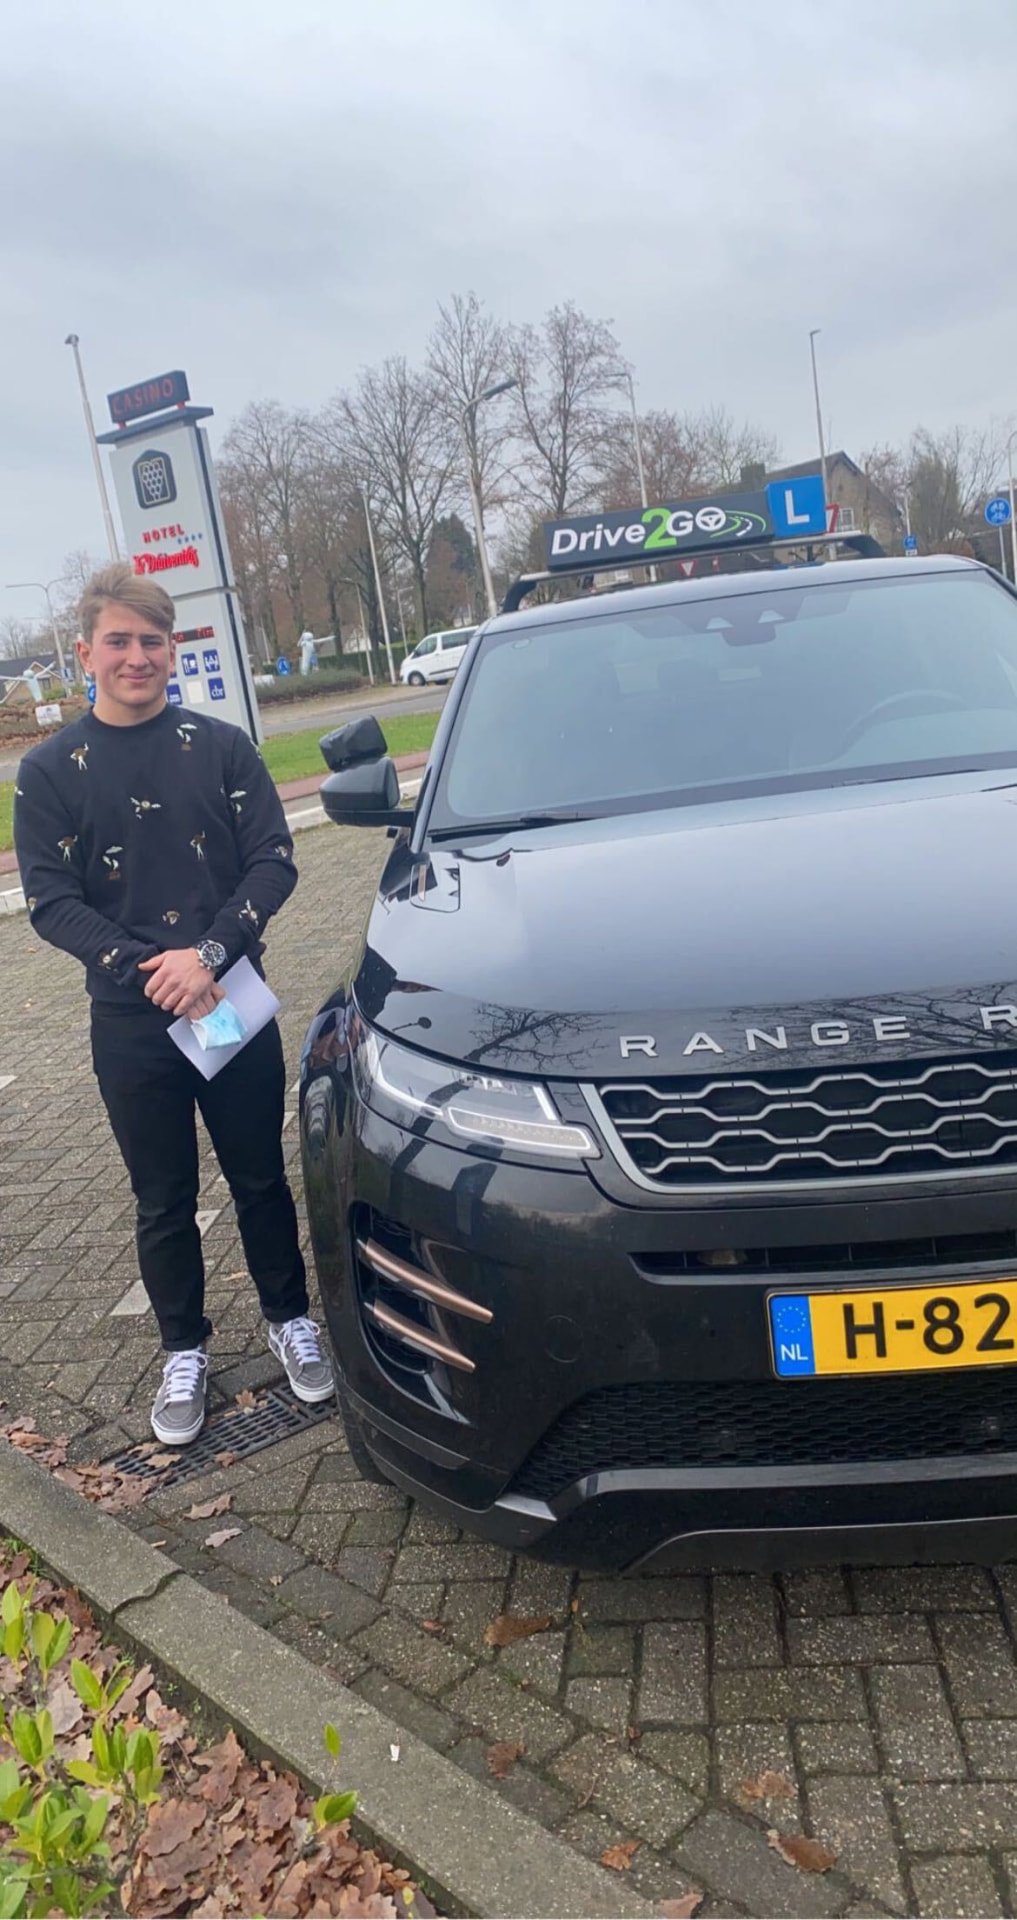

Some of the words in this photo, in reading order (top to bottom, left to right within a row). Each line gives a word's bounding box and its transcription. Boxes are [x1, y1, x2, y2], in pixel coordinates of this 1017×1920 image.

[112, 378, 174, 416] CASINO
[785, 489, 810, 525] L
[142, 524, 184, 544] HOTEL
[619, 1016, 910, 1058] RANGE
[842, 1293, 1015, 1360] H-82
[780, 1343, 808, 1361] NL
